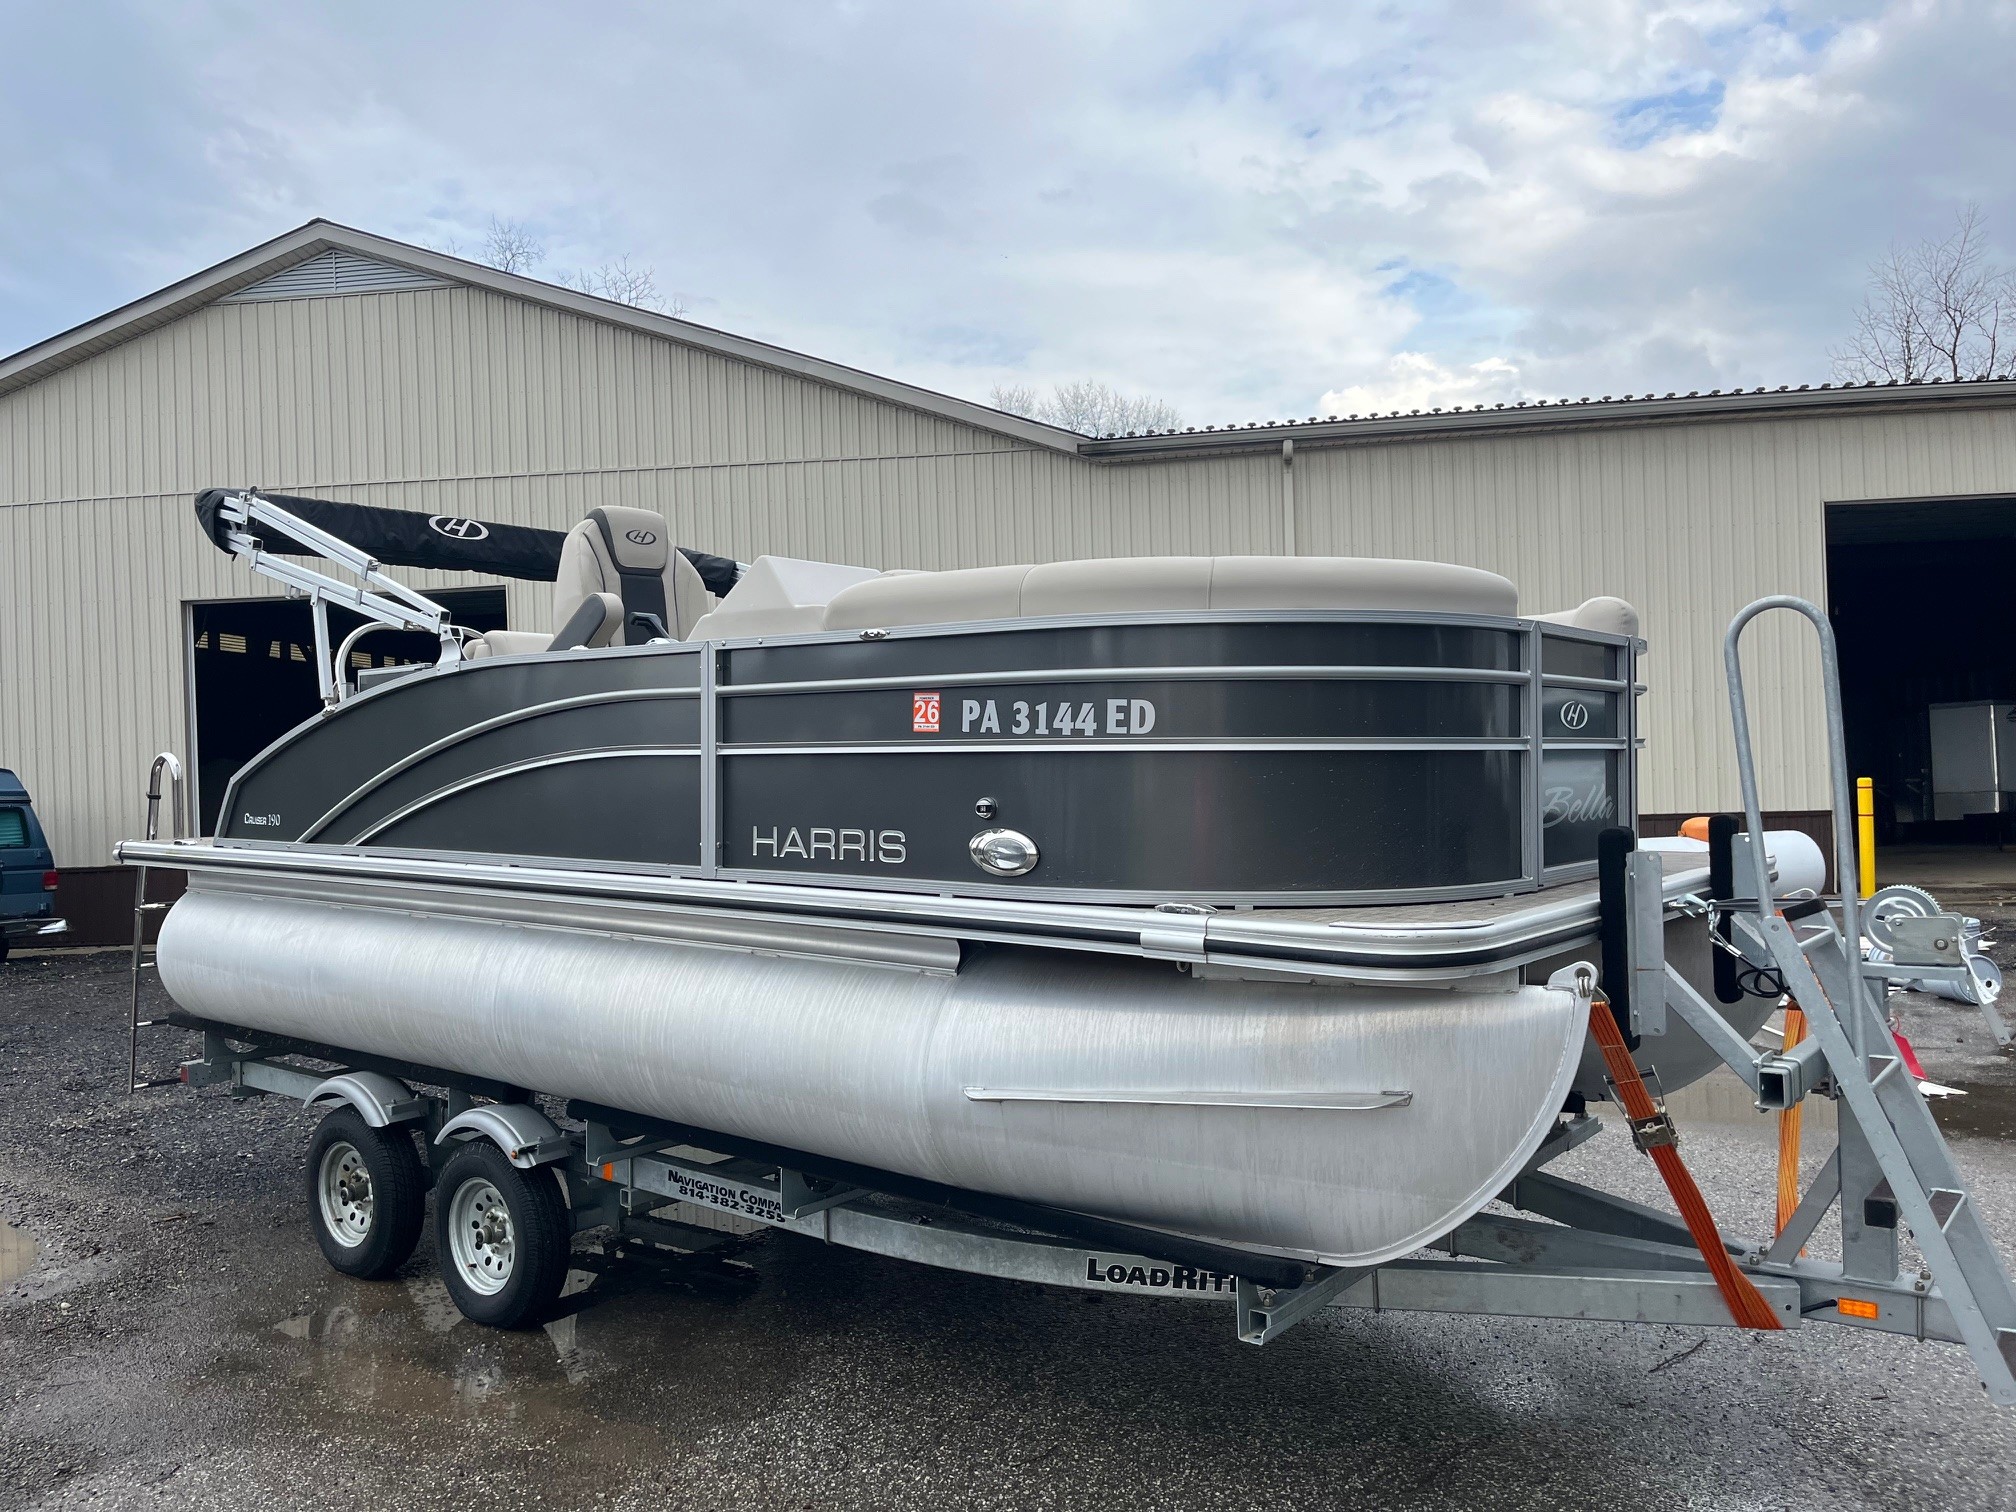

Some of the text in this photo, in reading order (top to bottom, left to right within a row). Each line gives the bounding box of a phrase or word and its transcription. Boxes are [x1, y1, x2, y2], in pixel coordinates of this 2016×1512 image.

[914, 700, 940, 724] 26
[962, 698, 1156, 737] PA 3144 ED
[267, 813, 281, 827] 190
[1542, 783, 1616, 829] Bella
[752, 825, 907, 864] HARRIS
[667, 1169, 737, 1200] NAVIGATION
[678, 1185, 787, 1224] 814-382-3255
